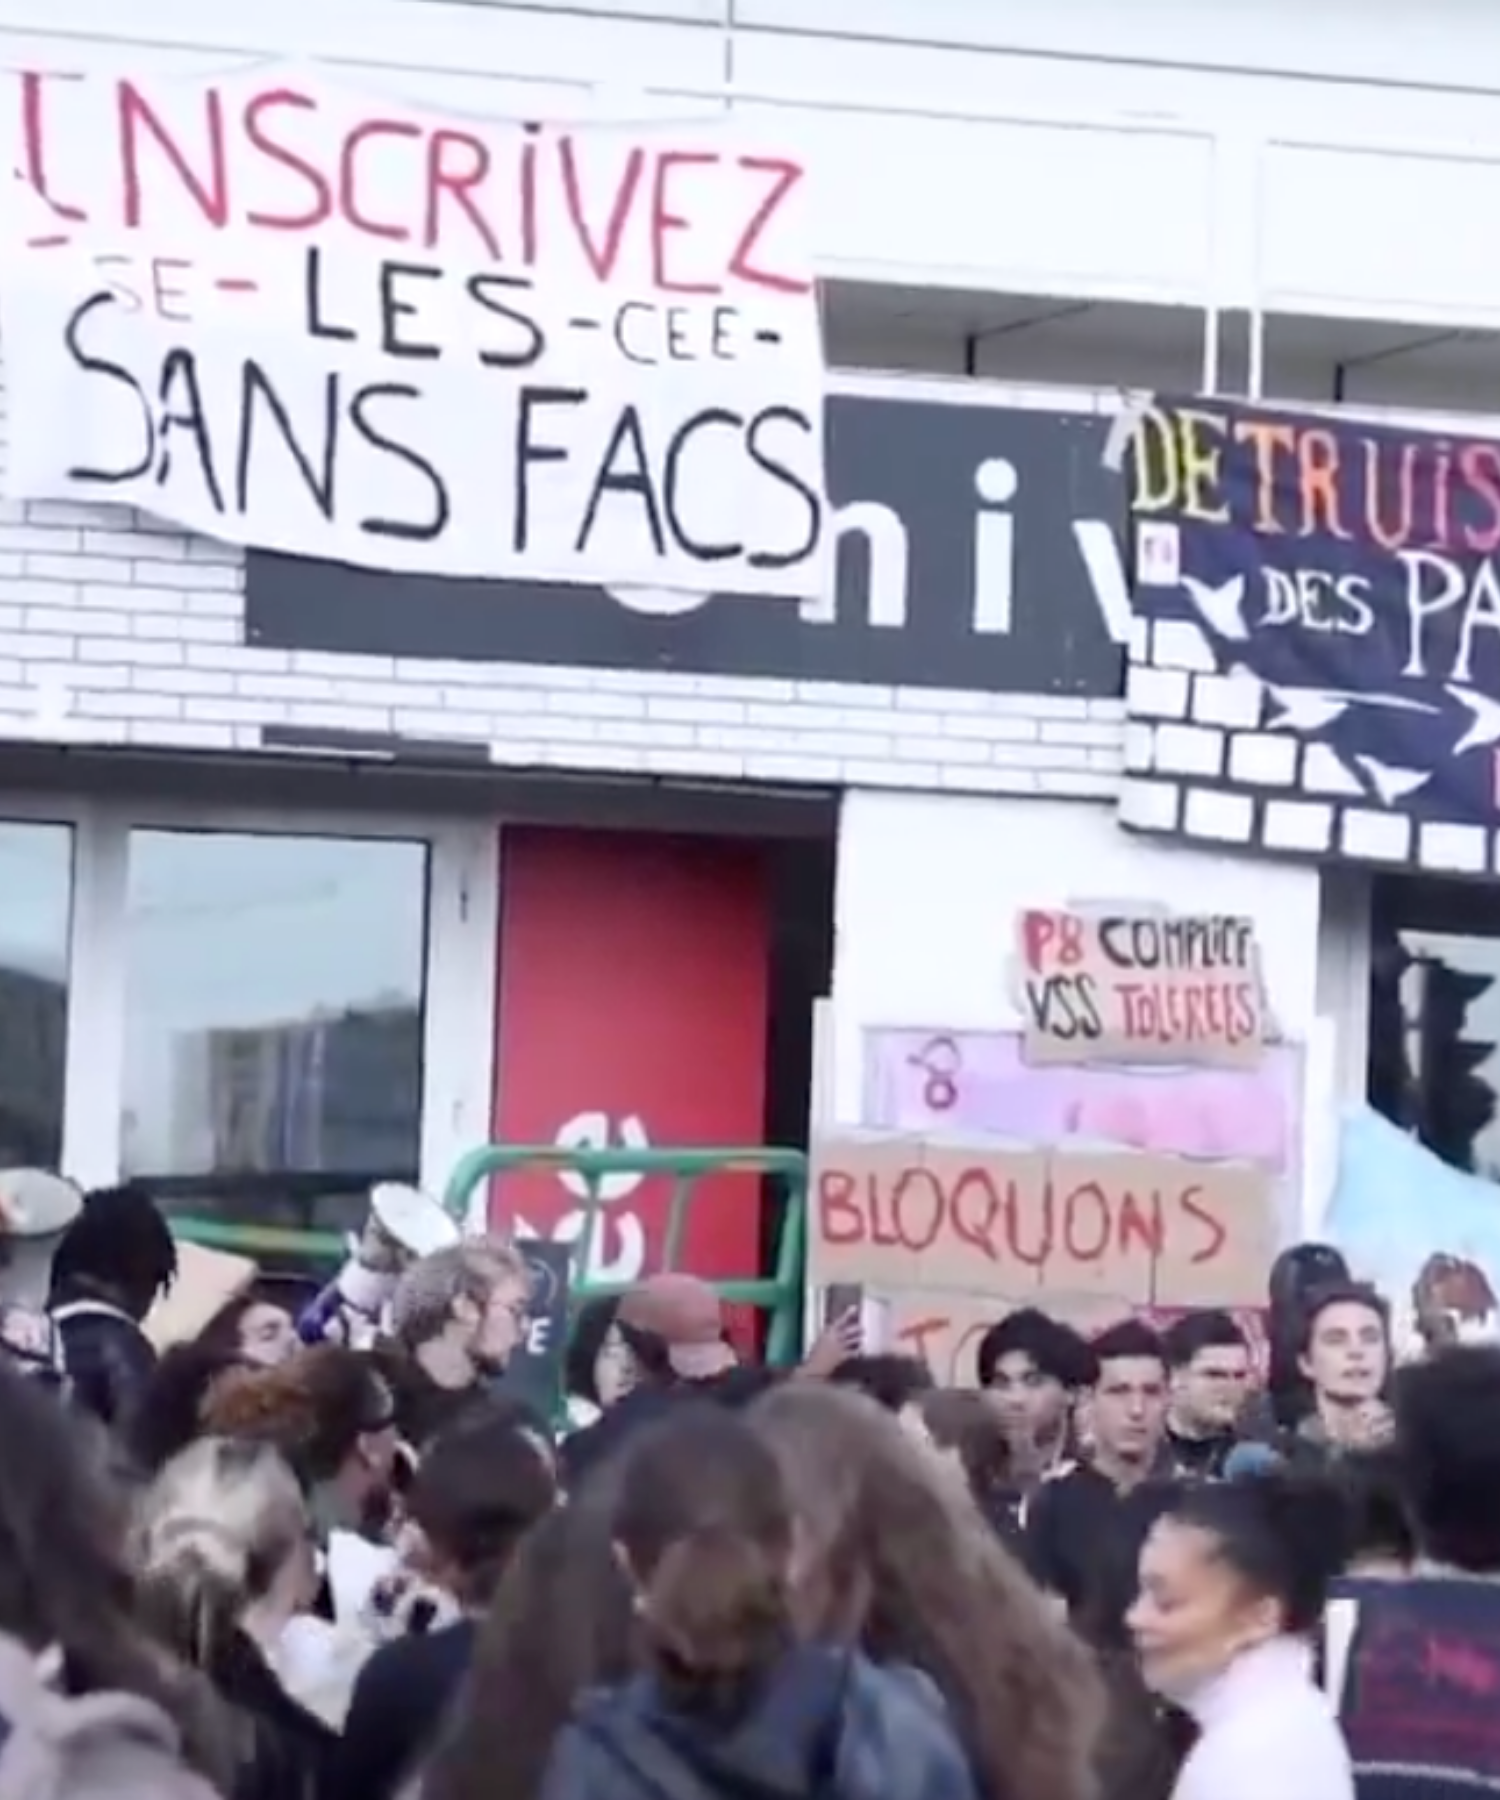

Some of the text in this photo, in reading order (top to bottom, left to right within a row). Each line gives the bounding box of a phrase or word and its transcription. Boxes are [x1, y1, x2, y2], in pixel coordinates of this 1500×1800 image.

[307, 246, 546, 368] LES
[65, 291, 822, 568] SANS FACS
[1258, 565, 1375, 635] DES
[1022, 909, 1084, 975] P8
[1025, 971, 1103, 1040] VSS
[817, 1166, 1226, 1265] BLOQUONS
